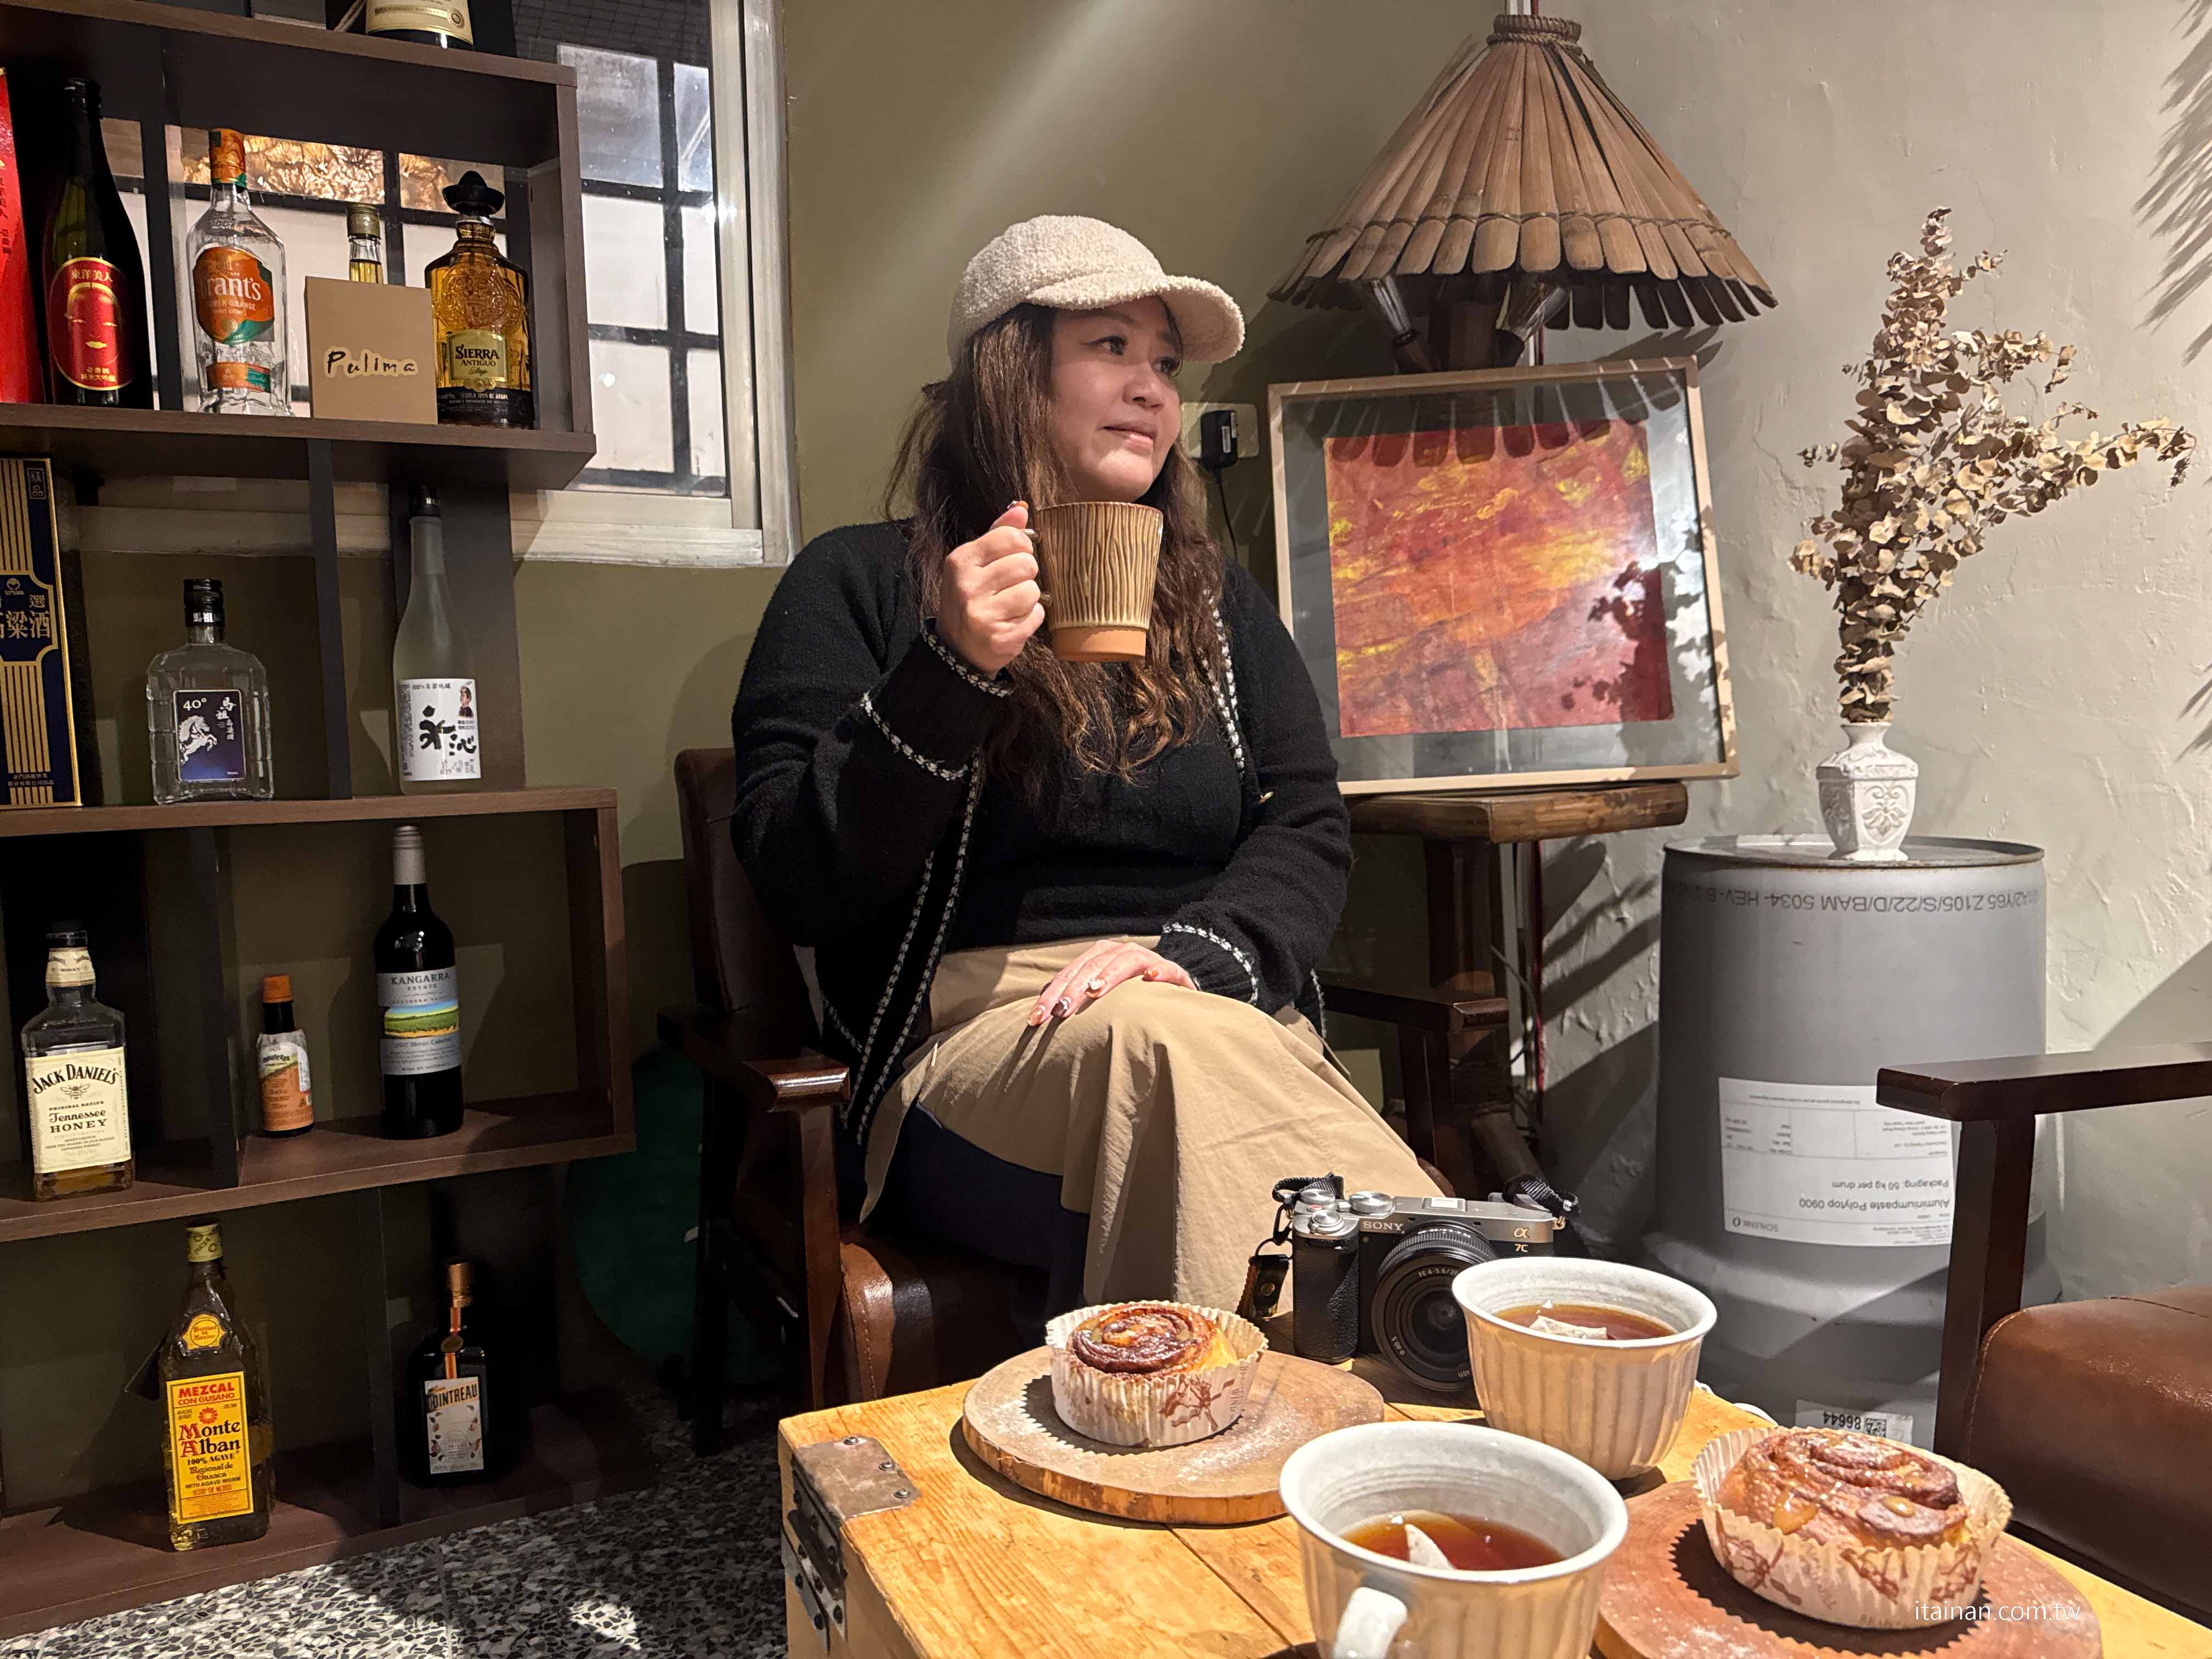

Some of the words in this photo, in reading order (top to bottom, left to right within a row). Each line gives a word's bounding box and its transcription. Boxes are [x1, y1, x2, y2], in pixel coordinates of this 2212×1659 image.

[455, 344, 500, 360] SIERRA
[0, 610, 51, 639] 粱酒
[1820, 895, 1984, 913] Z105/S/22/D/BAM
[391, 972, 449, 985] KANGARRA
[32, 1069, 65, 1094] JACK
[65, 1064, 119, 1085] DANIEL'S
[49, 1110, 106, 1124] Tennessee
[50, 1119, 108, 1133] HONEY
[1831, 1181, 1857, 1189] drum
[1858, 1180, 1873, 1190] per
[1874, 1180, 1886, 1190] kg
[1888, 1181, 1900, 1190] 50
[1799, 1198, 1825, 1209] 0900
[1827, 1199, 1867, 1211] Polytop
[1869, 1198, 1950, 1211] Aluminiumpaste
[1363, 1221, 1403, 1231] SONY
[1514, 1243, 1528, 1252] 7C
[178, 1381, 235, 1398] MEZCAL
[198, 1392, 235, 1403] GUSANO
[1822, 1412, 1861, 1430] 86644
[178, 1419, 241, 1441] Monte
[180, 1438, 241, 1458] Alban
[187, 1457, 208, 1465] 100%
[209, 1453, 235, 1463] AGAVE
[189, 1463, 224, 1475] Regional
[196, 1472, 227, 1481] Oaxaca
